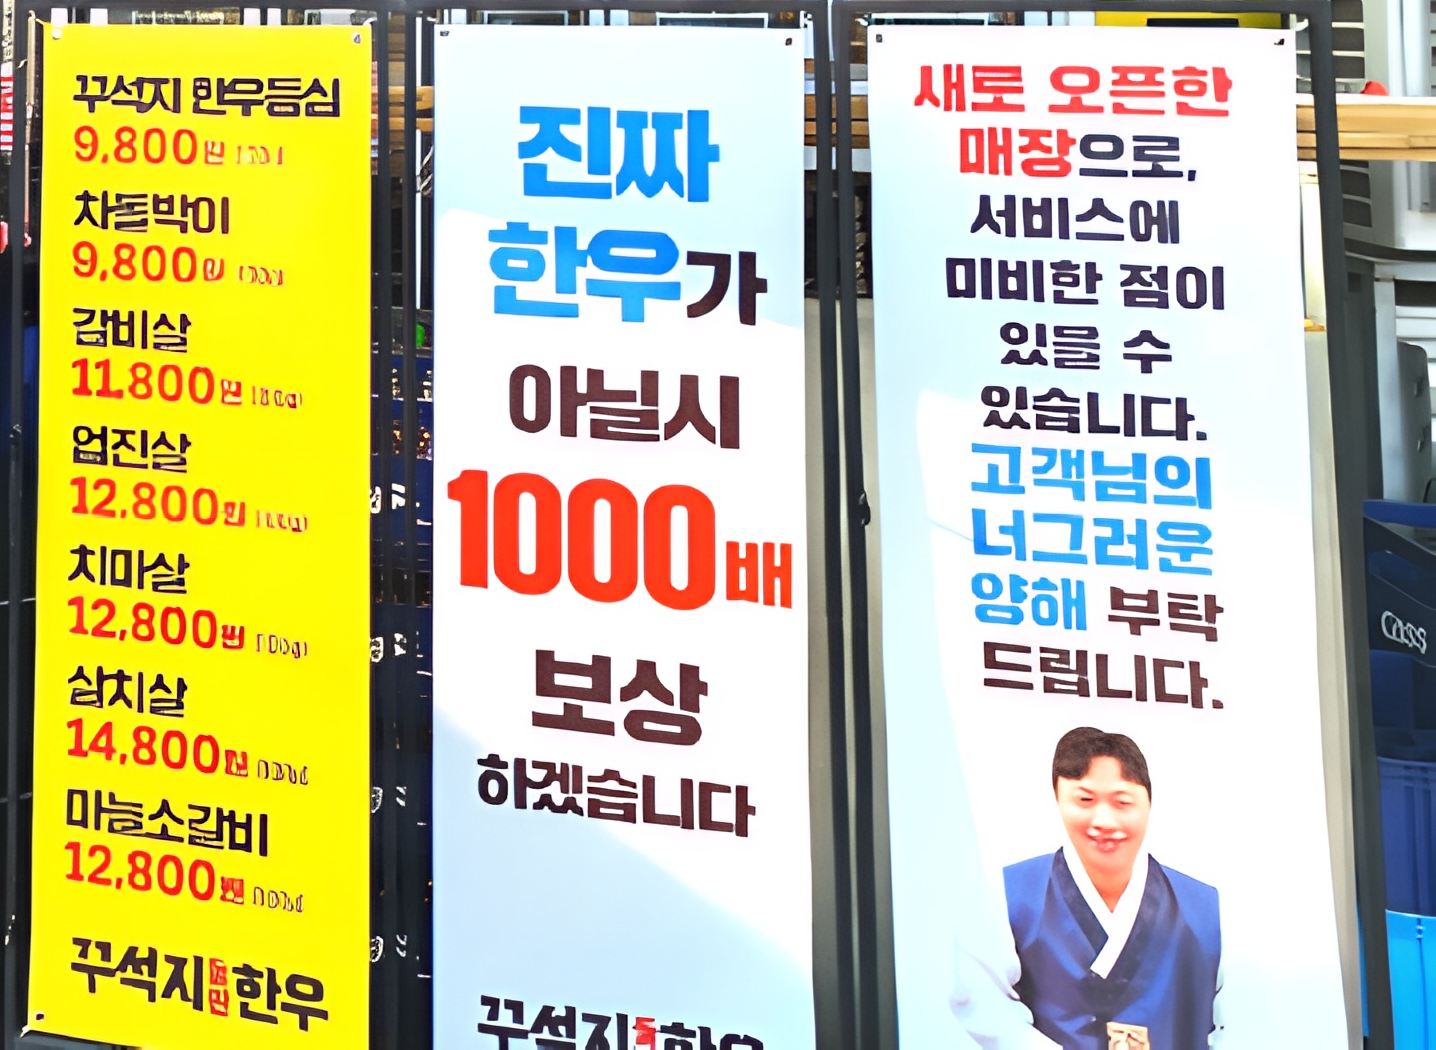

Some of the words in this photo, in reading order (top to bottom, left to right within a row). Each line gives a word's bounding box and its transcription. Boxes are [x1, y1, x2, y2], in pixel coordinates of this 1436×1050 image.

[914, 64, 1025, 112] 새로
[1048, 65, 1233, 117] 오픈한
[517, 106, 720, 203] 진짜
[959, 127, 1197, 182] 매장으로,
[970, 194, 1180, 244] 서비스에
[488, 222, 768, 326] 한우가
[945, 257, 1103, 305] 미비한
[1119, 264, 1224, 310] 점이
[1000, 322, 1101, 370] 있을
[1123, 330, 1173, 374] 수
[509, 363, 740, 450] 아닐시
[981, 385, 1208, 441] 있습니다.
[971, 443, 1212, 510] 고객님의
[68, 544, 191, 594] 치마살
[447, 469, 793, 611] 1000배
[972, 507, 1213, 576] 너그러운
[971, 572, 1087, 631] 양해
[1107, 586, 1224, 642] 부탁
[532, 649, 708, 746] 보상
[983, 641, 1224, 709] 드립니다.
[477, 753, 756, 838] 하겠습니다
[71, 937, 204, 1012] 꾸석지
[232, 963, 329, 1032] 한우
